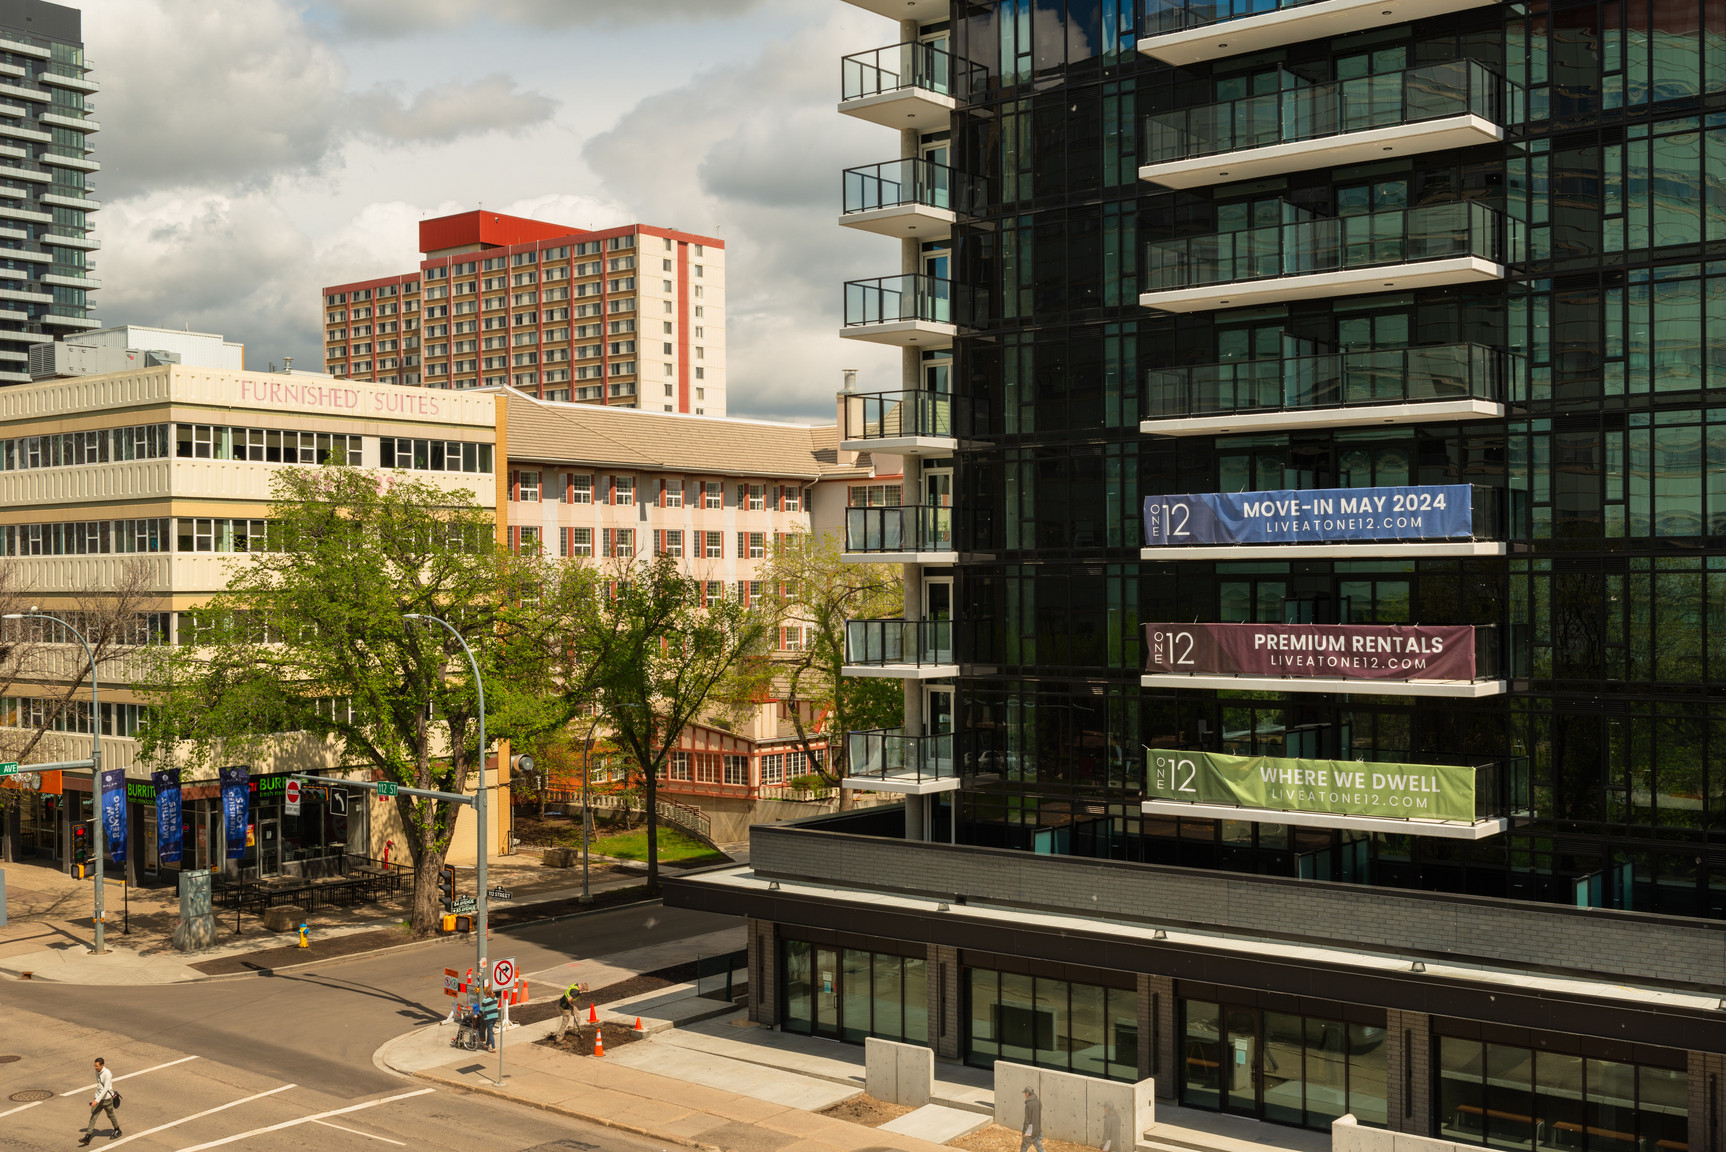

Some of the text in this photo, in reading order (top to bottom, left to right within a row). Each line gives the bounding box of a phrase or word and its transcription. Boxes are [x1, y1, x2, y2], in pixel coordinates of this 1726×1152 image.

[241, 380, 440, 416] FURNISHED SUITES
[1243, 493, 1447, 518] MOVE-IN MAY 2024
[1162, 503, 1190, 536] 12
[1266, 516, 1422, 533] LIVEATONE12.COM
[1167, 632, 1195, 665] 12
[1254, 633, 1444, 654] PREMIUM RENTALS
[1271, 654, 1427, 670] LIVEATONE12.COM
[3, 764, 17, 773] AVE
[1168, 759, 1197, 793] 12
[1260, 767, 1441, 793] WHERE WE DWELL
[378, 783, 397, 795] 112 ST
[1272, 788, 1428, 809] LIVEATONE12.COM
[161, 797, 169, 839] MONTHLY
[169, 801, 177, 832] RATES
[235, 797, 244, 829] LOFTS
